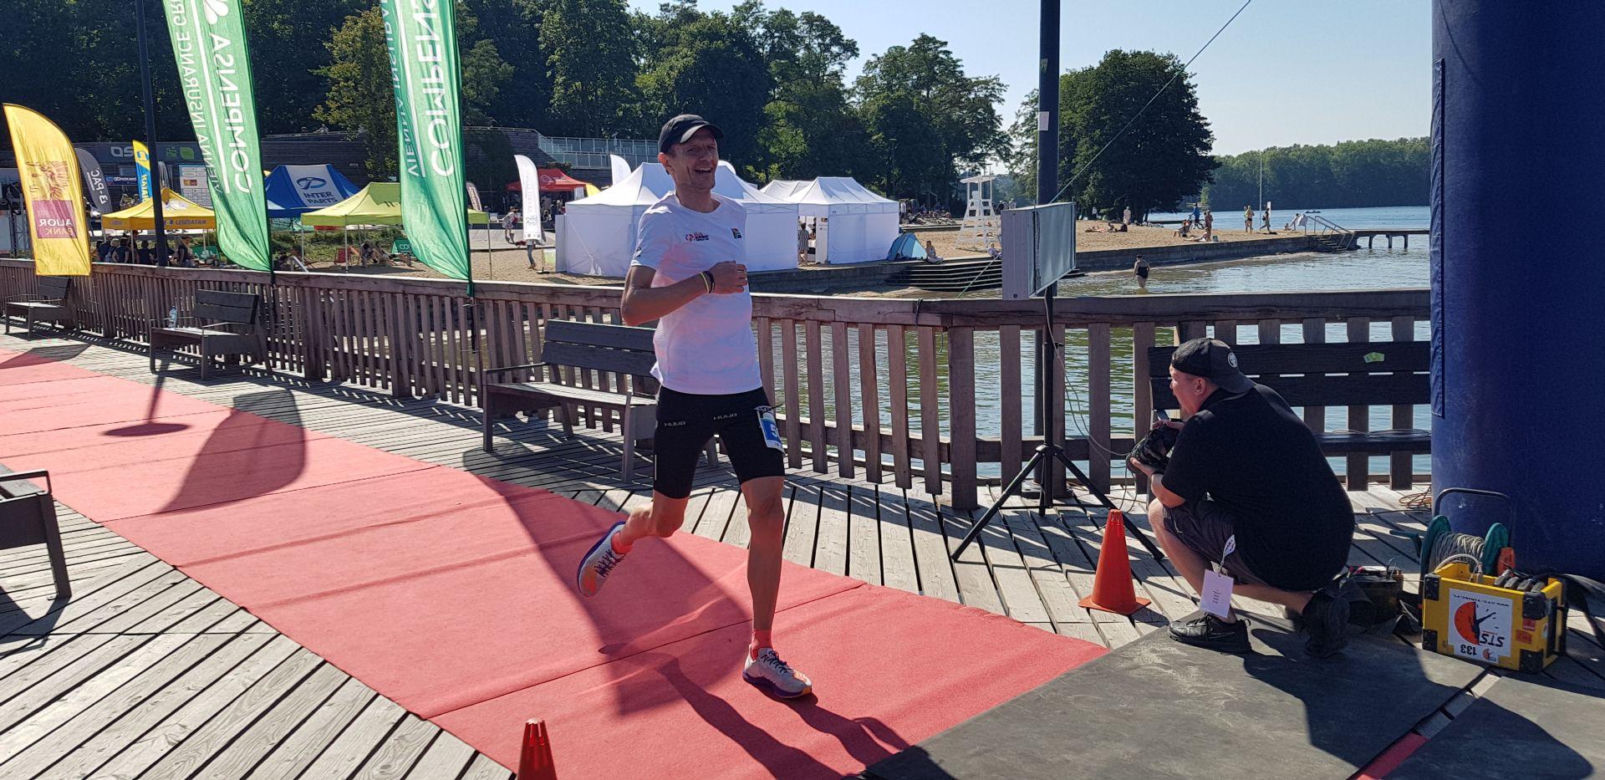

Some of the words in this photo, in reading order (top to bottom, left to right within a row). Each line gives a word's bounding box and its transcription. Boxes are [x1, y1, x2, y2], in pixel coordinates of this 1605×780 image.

[303, 191, 333, 199] INTER
[1480, 633, 1505, 648] STS
[1460, 643, 1478, 656] 133
